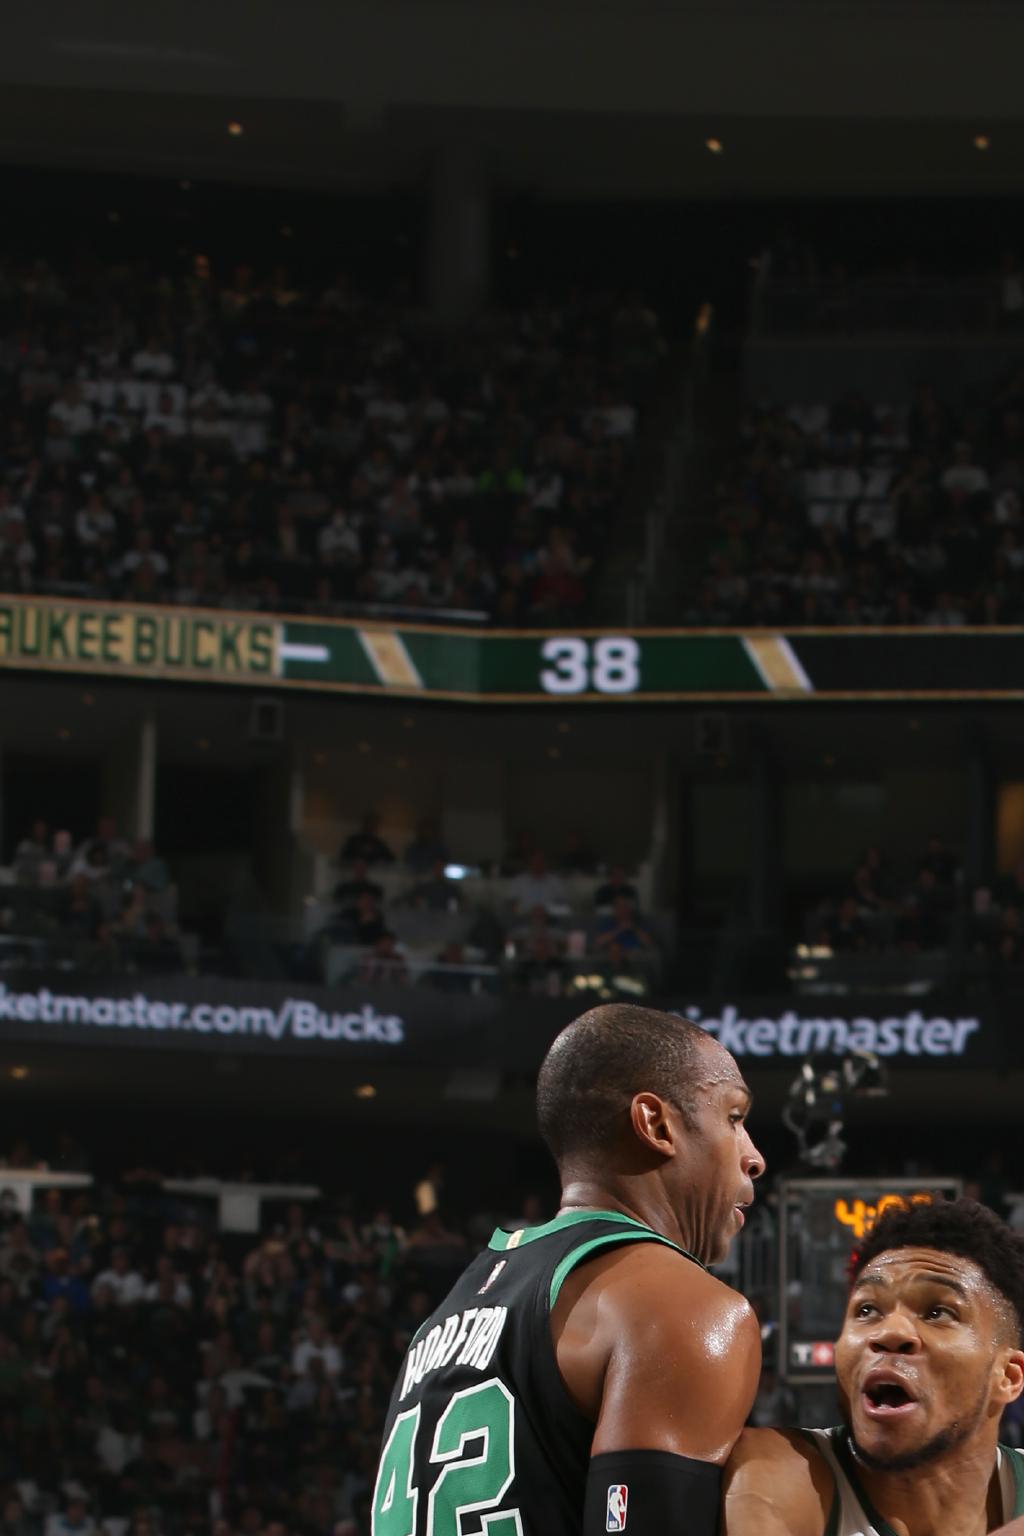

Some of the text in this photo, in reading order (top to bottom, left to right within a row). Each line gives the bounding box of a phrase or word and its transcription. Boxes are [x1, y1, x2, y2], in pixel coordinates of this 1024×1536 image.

[133, 615, 274, 674] BUCKS
[541, 636, 639, 694] 38
[686, 1005, 979, 1056] ketmaster
